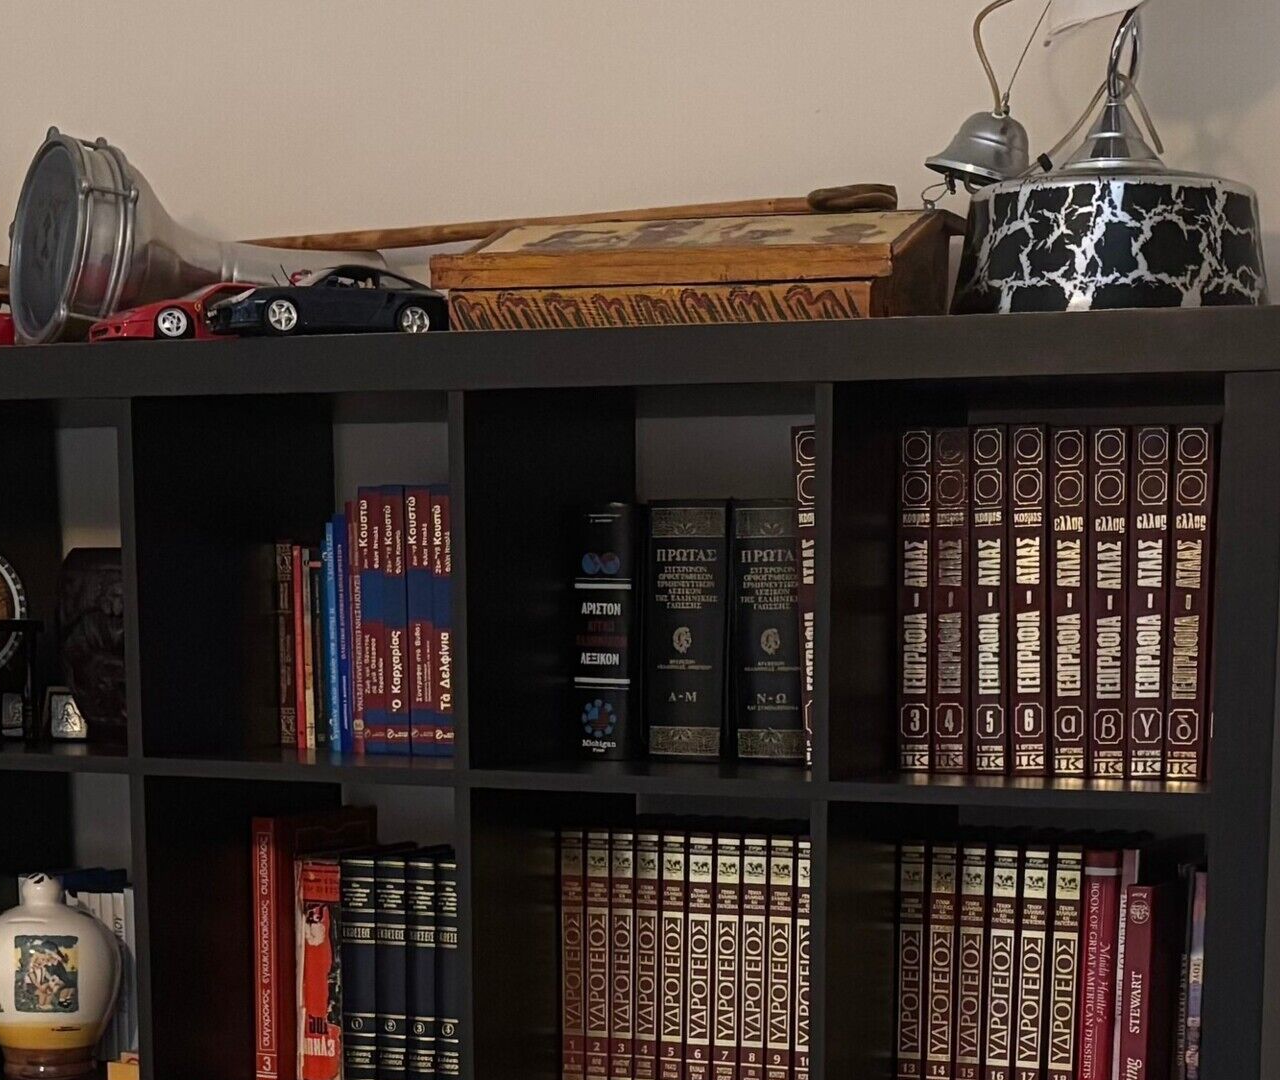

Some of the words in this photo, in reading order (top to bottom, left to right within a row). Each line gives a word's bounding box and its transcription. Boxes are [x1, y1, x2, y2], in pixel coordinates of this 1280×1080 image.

[904, 540, 928, 588] ΑΤΛΑΣ
[978, 538, 1000, 586] ΑΤΛΑΣ
[1017, 537, 1039, 584] ΑΤΛΑΣ
[1057, 539, 1080, 587] ΑΤΛΑΣ
[1097, 541, 1121, 589] ΑΤΛΑΣ
[1175, 540, 1202, 589] ΑΤΛΑΣ
[581, 652, 619, 665] ΛΕΞΙΚΟΝ
[1017, 611, 1040, 693] ΓΕΩΓΡΑΦΙΑ
[1090, 882, 1100, 914] BOOK
[1089, 915, 1099, 930] OF
[1087, 931, 1098, 967] GREAT
[665, 918, 680, 1034] ΥΔΡΟΓΕΙΟΣ
[690, 922, 708, 1037] ΥΔΡΟΓΕΙΟΣ
[718, 921, 736, 1038] ΥΔΡΟΓΕΙΟΣ
[745, 922, 763, 1039] ΥΔΡΟΓΕΙΟΣ
[771, 924, 789, 1041] ΥΔΡΟΓΕΙΟΣ
[931, 933, 950, 1053] ΥΔΡΟΓΕΙΟΣ
[991, 937, 1011, 1058] ΥΔΡΟΓΕΙΟΣ
[1020, 940, 1041, 1059] ΥΔΡΟΓΕΙΟΣ
[1085, 968, 1097, 1028] AMERICAN
[1053, 943, 1074, 1062] ΥΔΡΟΓΕΙΟΣ
[1129, 971, 1143, 1034] STEWART
[668, 1046, 674, 1056] 5
[694, 1049, 701, 1059] 6
[722, 1050, 728, 1060] 7
[748, 1052, 755, 1063] 8
[773, 1054, 781, 1064] 9
[932, 1065, 945, 1075] 14
[1082, 1029, 1094, 1079] DESSERTS
[991, 1071, 1004, 1080] 16
